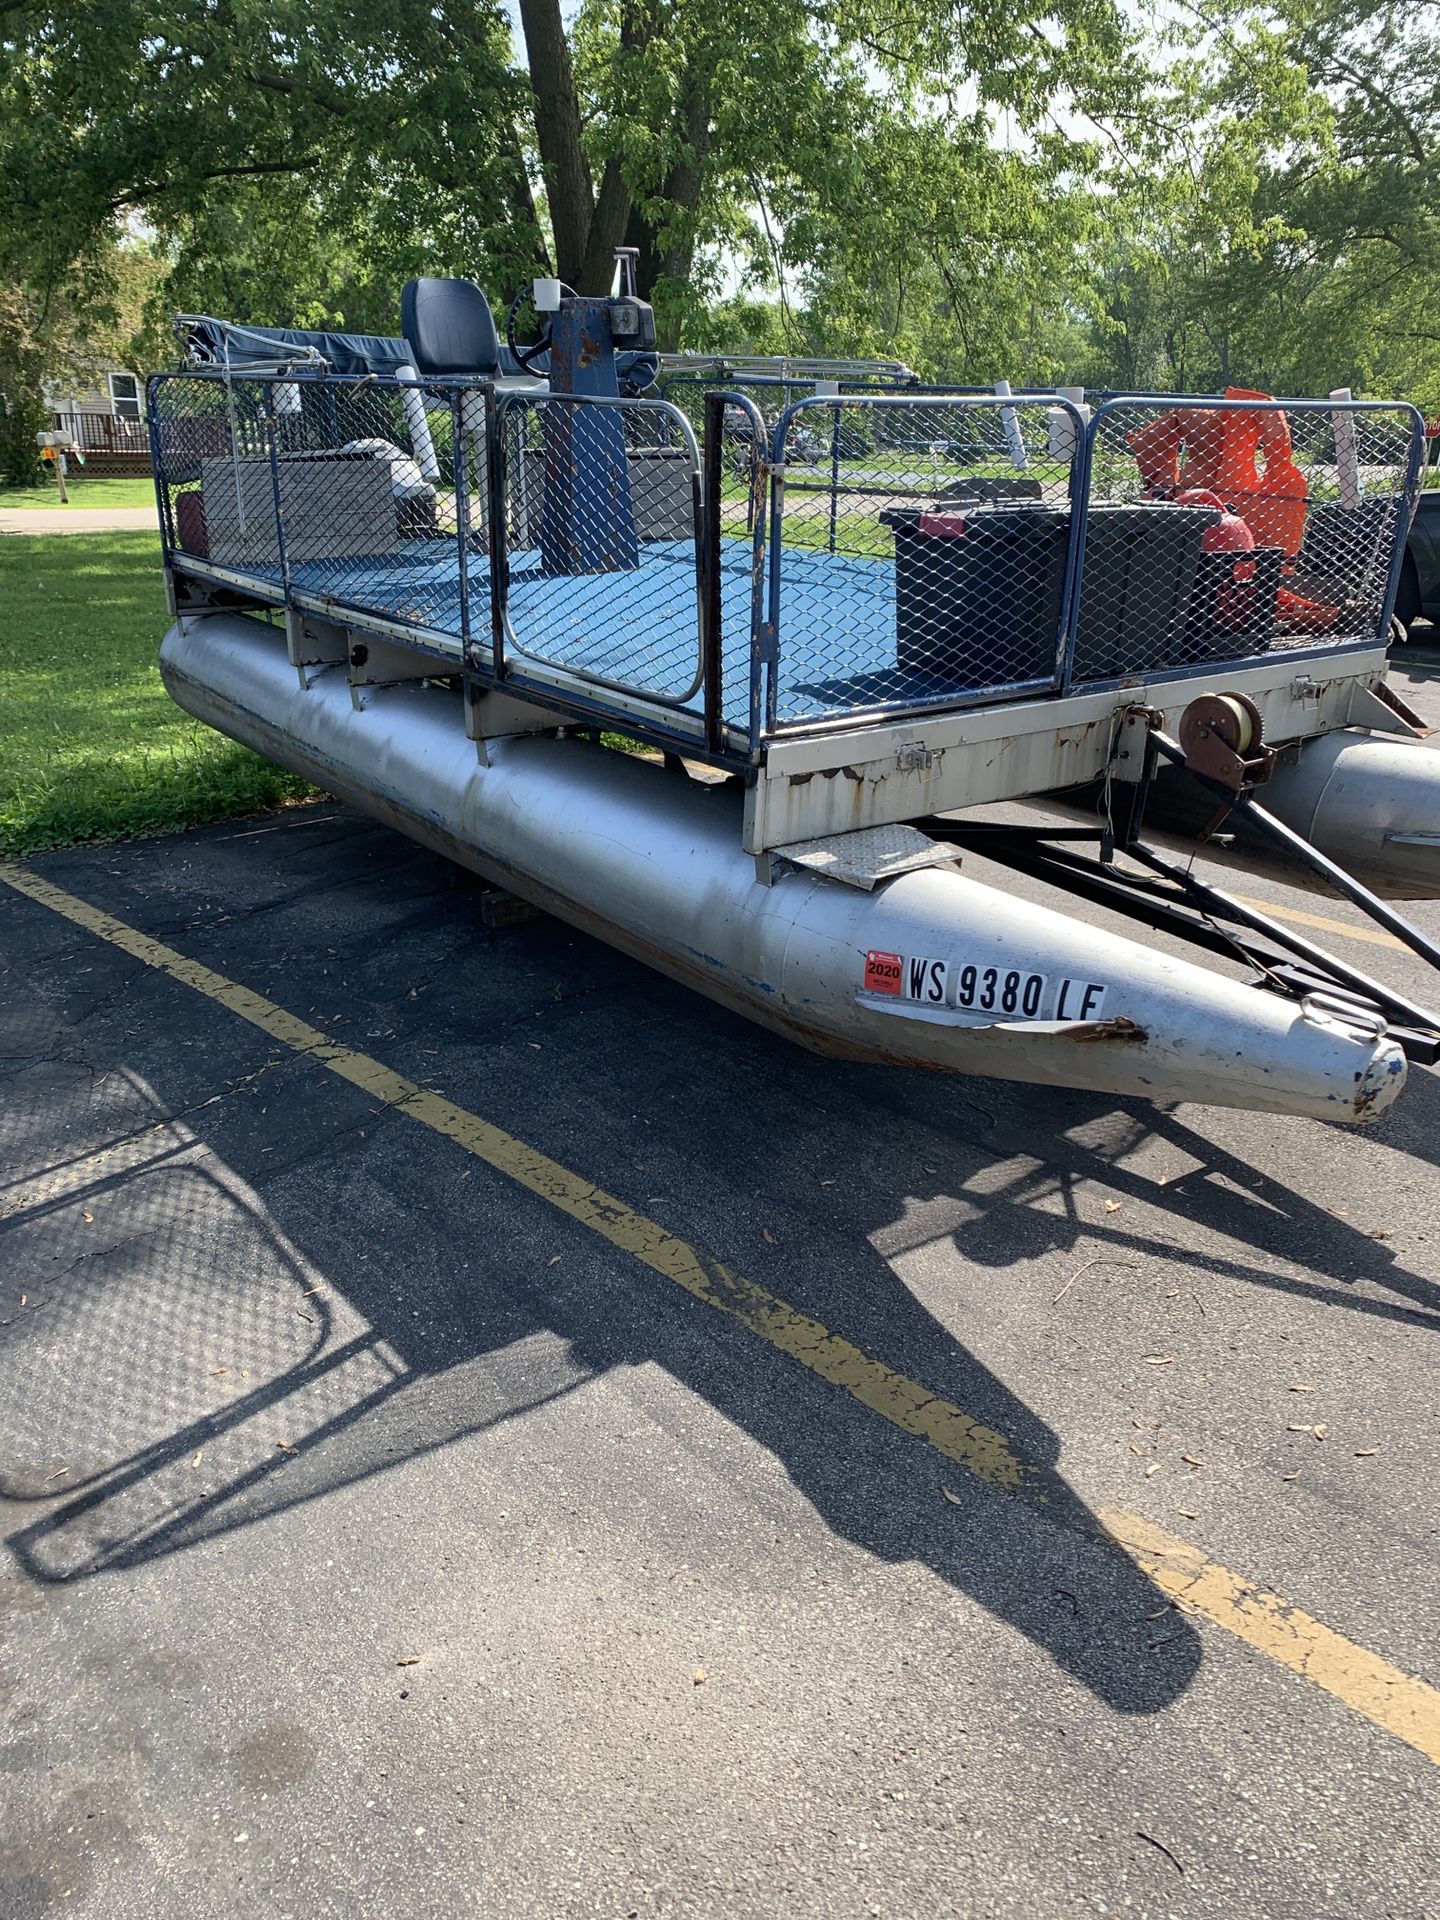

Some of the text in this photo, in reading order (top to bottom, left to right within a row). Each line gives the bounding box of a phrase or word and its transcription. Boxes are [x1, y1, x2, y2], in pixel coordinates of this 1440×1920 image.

[868, 962, 900, 979] 2020
[910, 957, 946, 1002] WS
[959, 965, 1043, 1017] 9380
